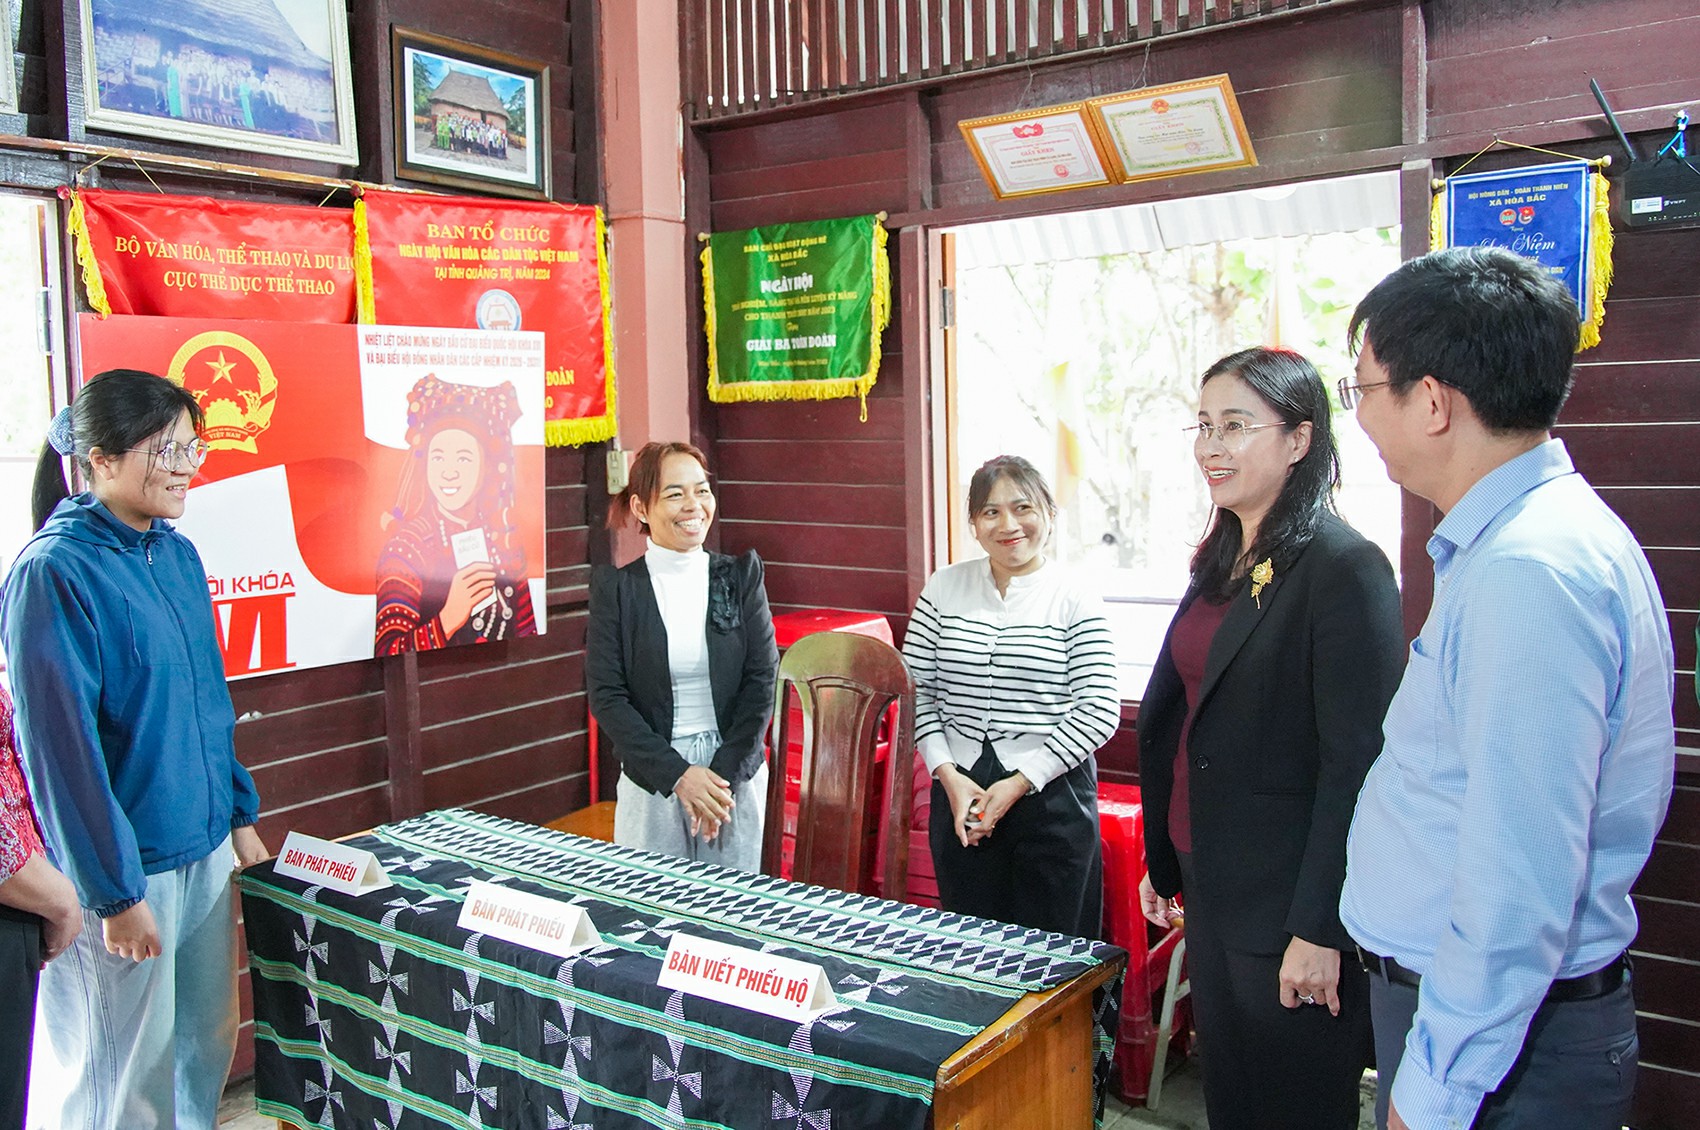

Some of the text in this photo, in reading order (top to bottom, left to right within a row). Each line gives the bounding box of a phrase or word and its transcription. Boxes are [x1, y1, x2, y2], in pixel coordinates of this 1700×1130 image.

[1527, 194, 1546, 203] BẮC
[427, 220, 550, 243] BAN TỔ CHỨC
[1512, 232, 1555, 254] Niệm
[115, 235, 141, 258] BỘ
[144, 238, 178, 258] VĂN
[182, 240, 215, 264] HÓA,
[216, 241, 247, 265] THỂ
[250, 250, 291, 267] THAO
[292, 249, 312, 269] VÀ
[315, 254, 334, 269] DU
[399, 243, 423, 258] NGÀY
[424, 243, 441, 261] HỘI
[442, 244, 461, 260] VĂN
[481, 246, 500, 261] CÁC
[501, 246, 522, 261] DÂN
[522, 246, 540, 264] TỘC
[540, 247, 556, 265] VIỆT
[557, 250, 579, 262] NAM
[163, 267, 335, 296] CỤC THỂ DỤC THỂ THAO
[434, 266, 447, 281] TẠI
[465, 264, 499, 280] QUẢNG
[761, 272, 813, 293] NGÀY HỘI
[746, 336, 772, 351] GIẢI
[774, 338, 791, 350] BA
[808, 332, 837, 348] ĐOÀN
[207, 570, 295, 600] ỘI KHÓA
[212, 592, 296, 677] VI
[284, 848, 357, 882] BÀN PHÁT PHIẾU
[471, 898, 565, 940] BÀN PHÁT PHIẾU
[668, 949, 808, 1008] BÀN VIẾT PHIẾU HỘ
